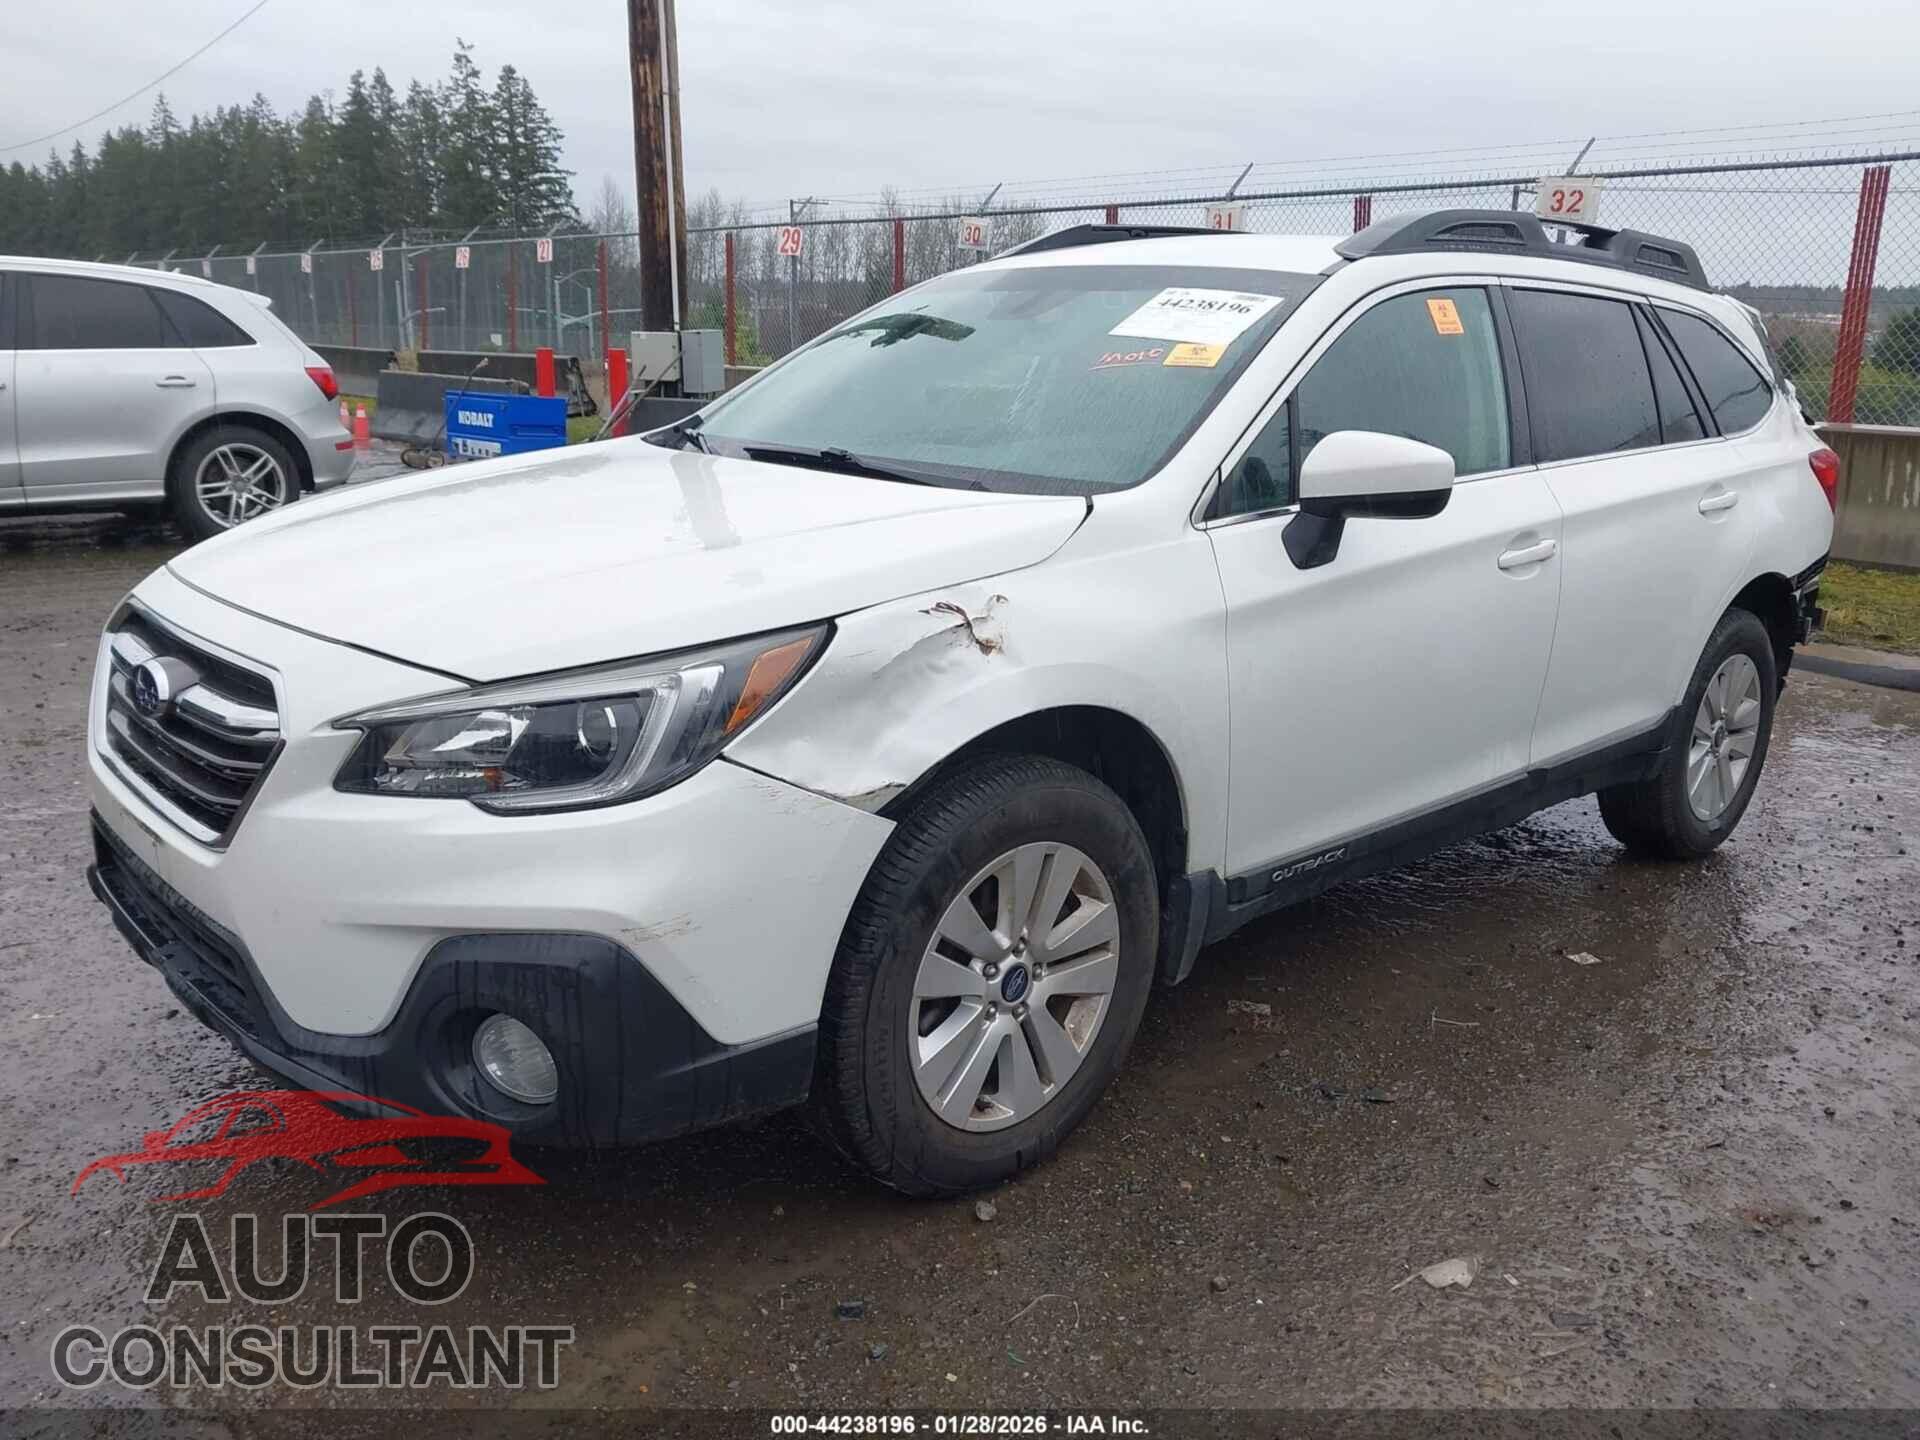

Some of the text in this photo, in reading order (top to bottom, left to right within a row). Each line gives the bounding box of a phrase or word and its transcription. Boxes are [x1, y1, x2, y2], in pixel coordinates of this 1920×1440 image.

[1550, 189, 1584, 213] 32
[780, 228, 801, 254] 29
[964, 225, 981, 243] 30
[457, 246, 469, 267] 26
[539, 240, 551, 261] 27
[1157, 299, 1252, 314] 44238196
[458, 410, 494, 428] KOBALT
[1271, 847, 1347, 882] OUTBACK
